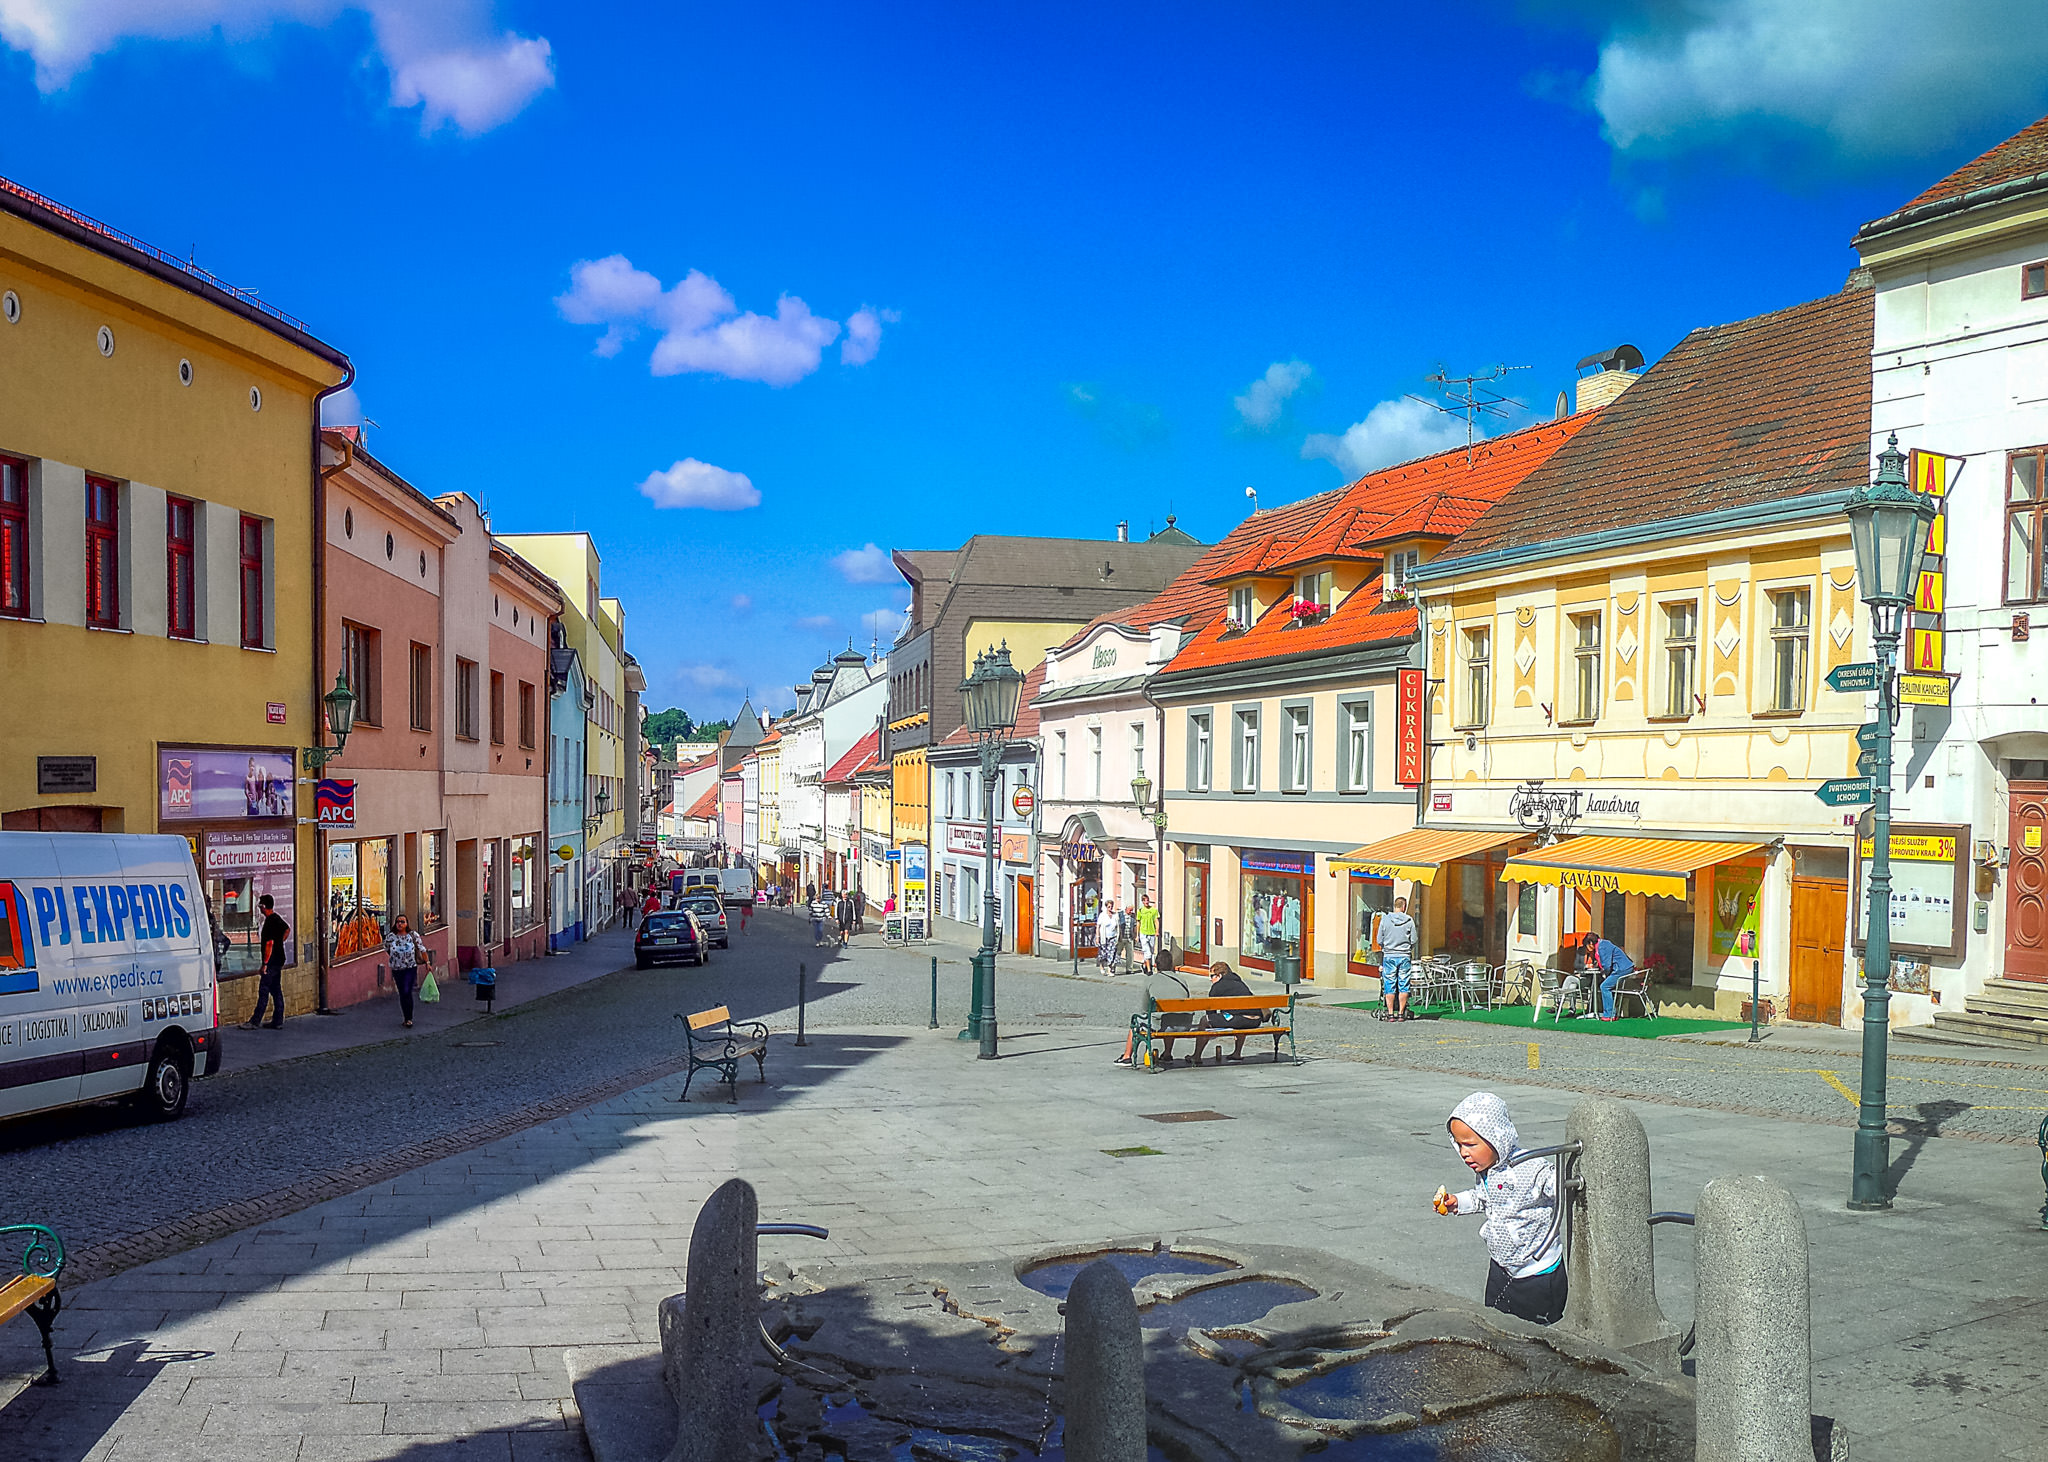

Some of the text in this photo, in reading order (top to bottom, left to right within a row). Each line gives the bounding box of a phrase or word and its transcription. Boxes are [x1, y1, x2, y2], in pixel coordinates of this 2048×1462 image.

[1404, 673, 1416, 780] CUKRÁRNA
[170, 789, 190, 804] APC
[1828, 781, 1870, 793] SVATOHORSKÉ
[1586, 793, 1640, 812] kavárna
[1836, 792, 1861, 802] SCHODY
[319, 806, 353, 821] APC
[1907, 838, 1928, 846] SLUŽBY
[1937, 838, 1954, 858] 3%
[208, 845, 292, 867] Centrum zájezdů
[1894, 848, 1915, 856] PROVIZI
[1560, 870, 1620, 889] KAVÁRNA
[32, 883, 192, 947] PJ EXPEDIS
[53, 963, 164, 995] www.expedis.cz
[26, 1016, 69, 1042] LOGISTIKA
[82, 1005, 129, 1033] SKLADOVÁNÍ
